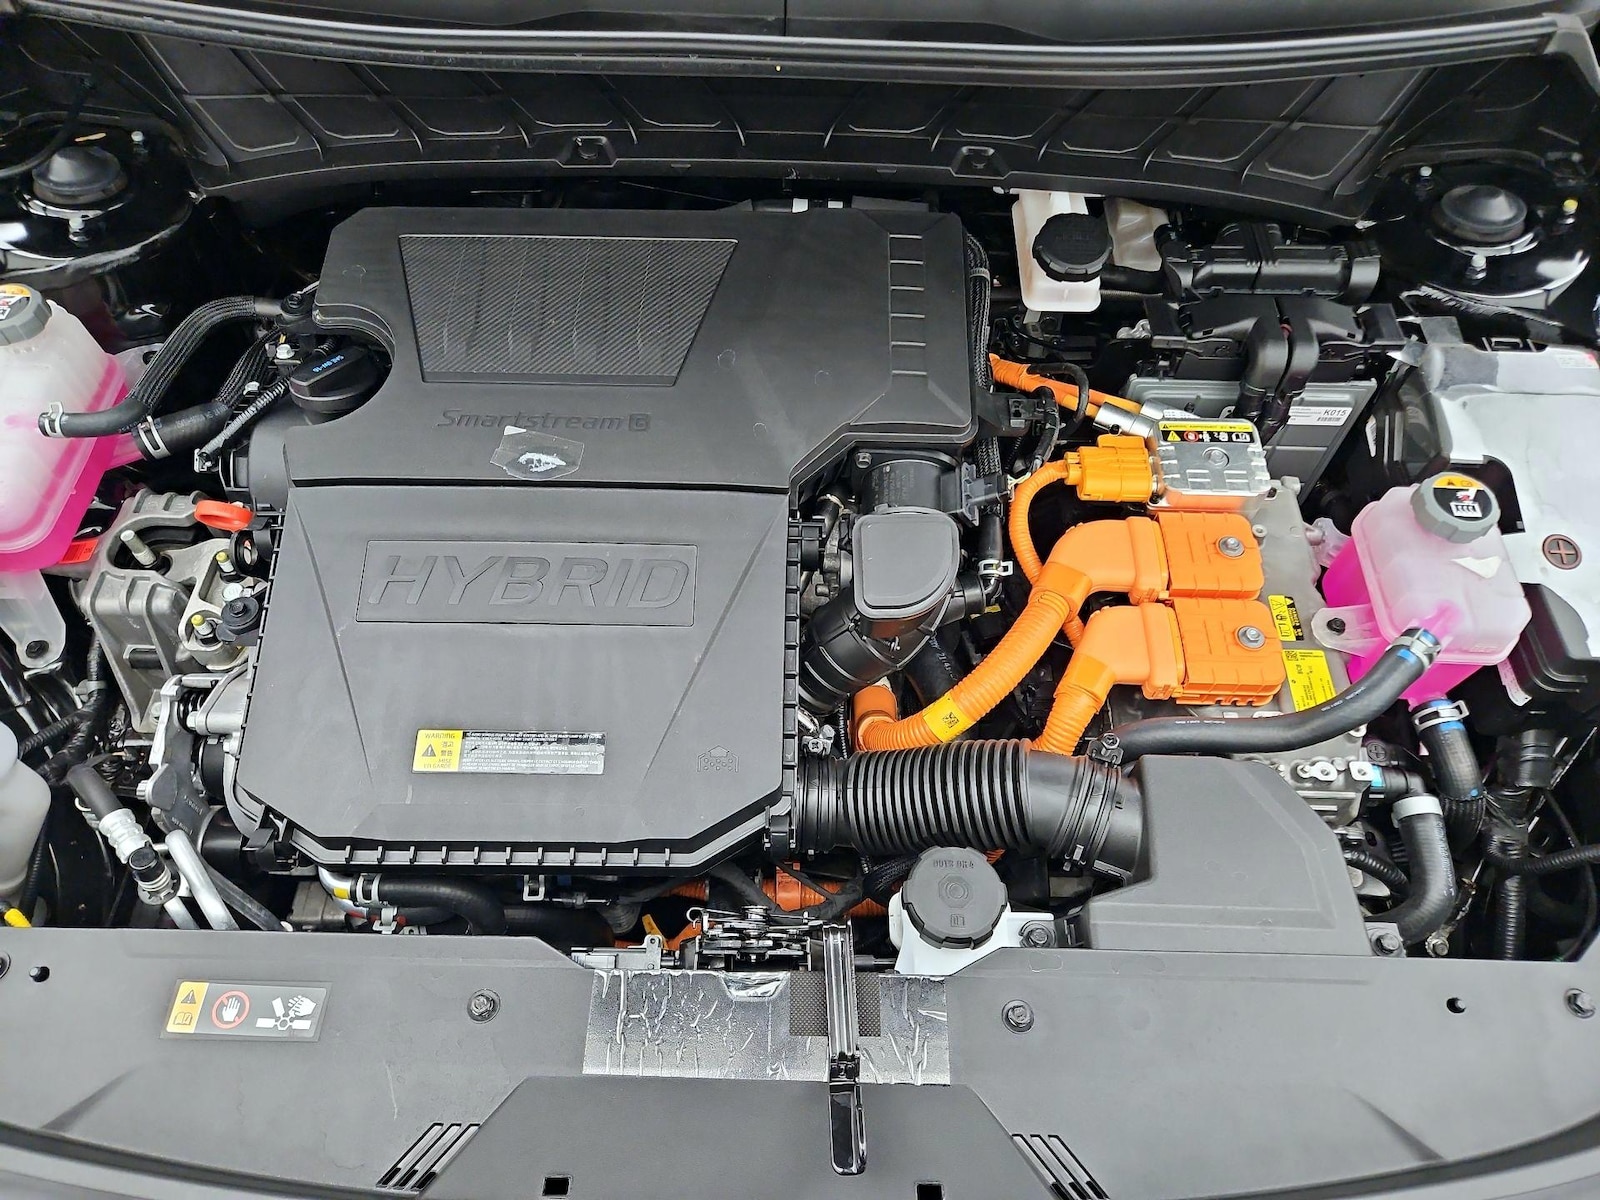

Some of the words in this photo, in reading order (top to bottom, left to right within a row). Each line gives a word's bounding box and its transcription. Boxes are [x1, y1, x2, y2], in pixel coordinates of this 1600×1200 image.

[437, 409, 622, 431] Smartstream
[1323, 409, 1348, 417] K015
[367, 555, 690, 609] HYBRID
